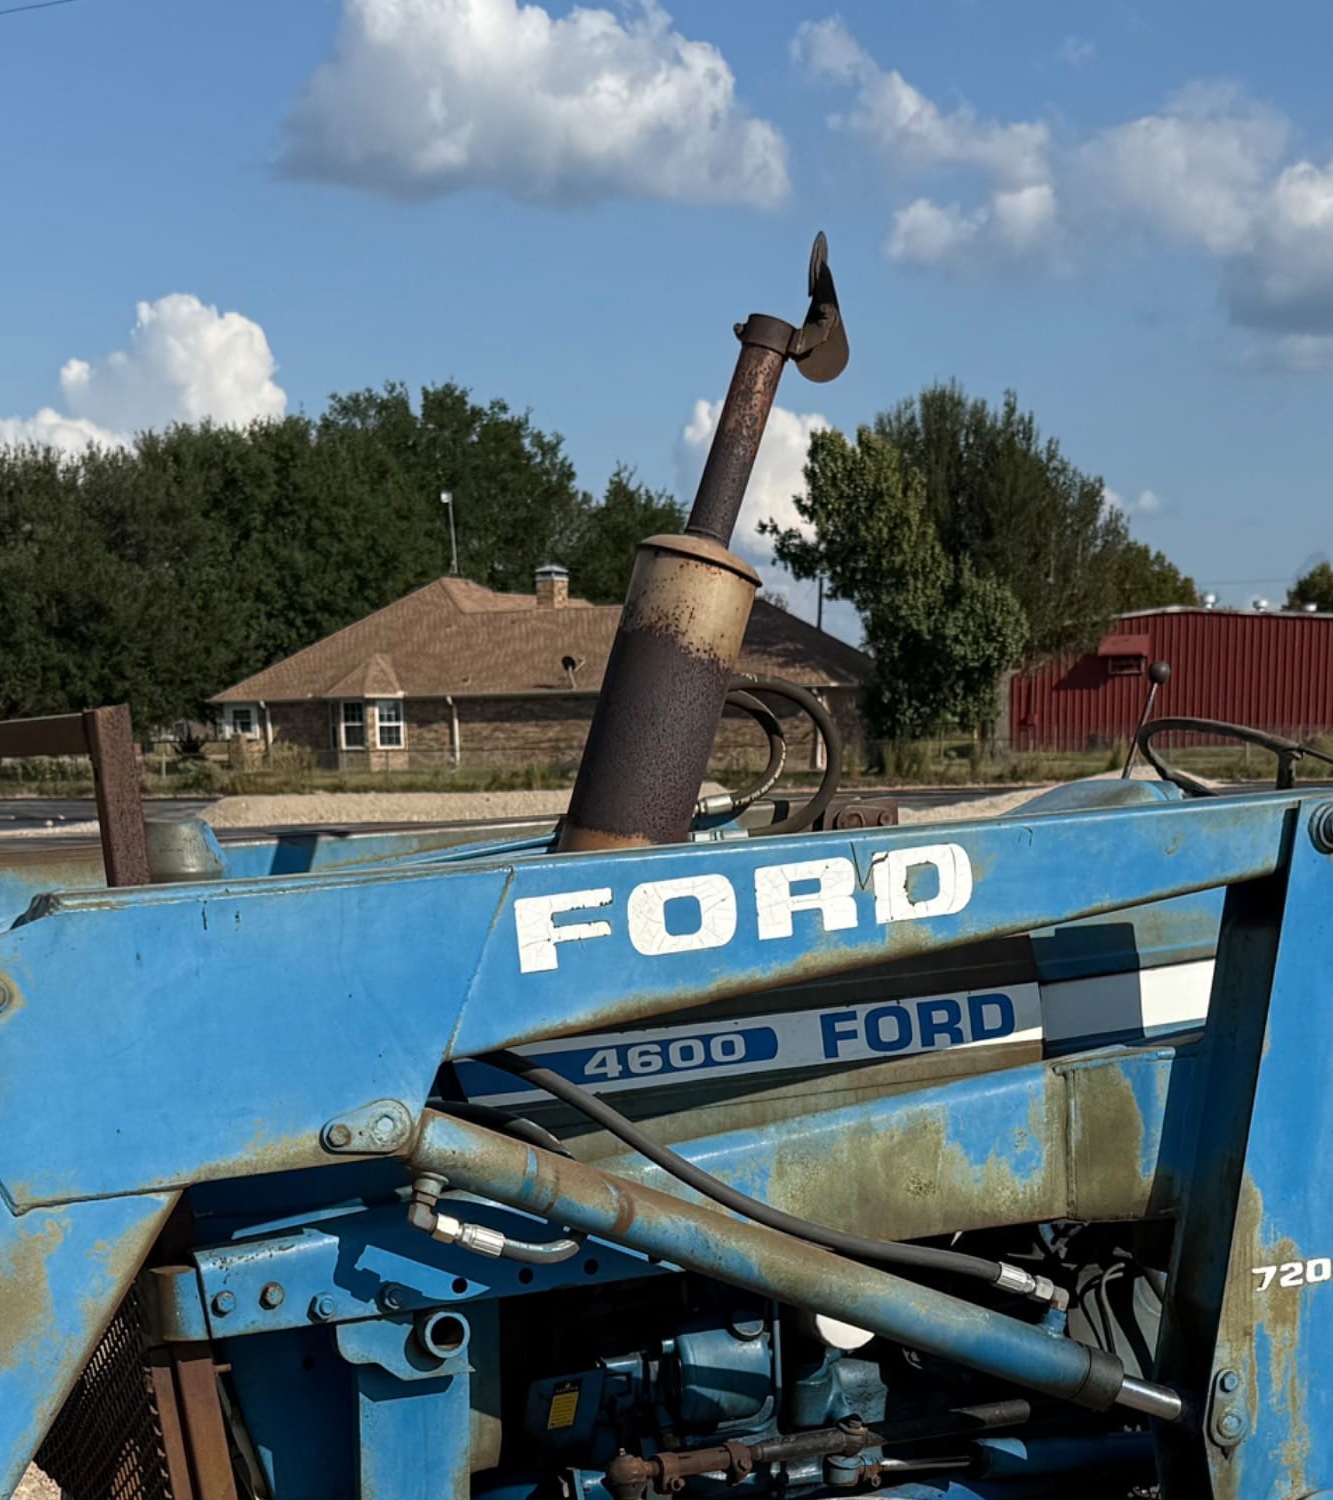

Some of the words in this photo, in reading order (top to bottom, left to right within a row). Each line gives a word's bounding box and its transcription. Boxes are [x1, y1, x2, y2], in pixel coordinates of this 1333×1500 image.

[515, 841, 973, 973] FORD
[582, 1031, 747, 1079] 4600
[820, 992, 1016, 1059] FORD
